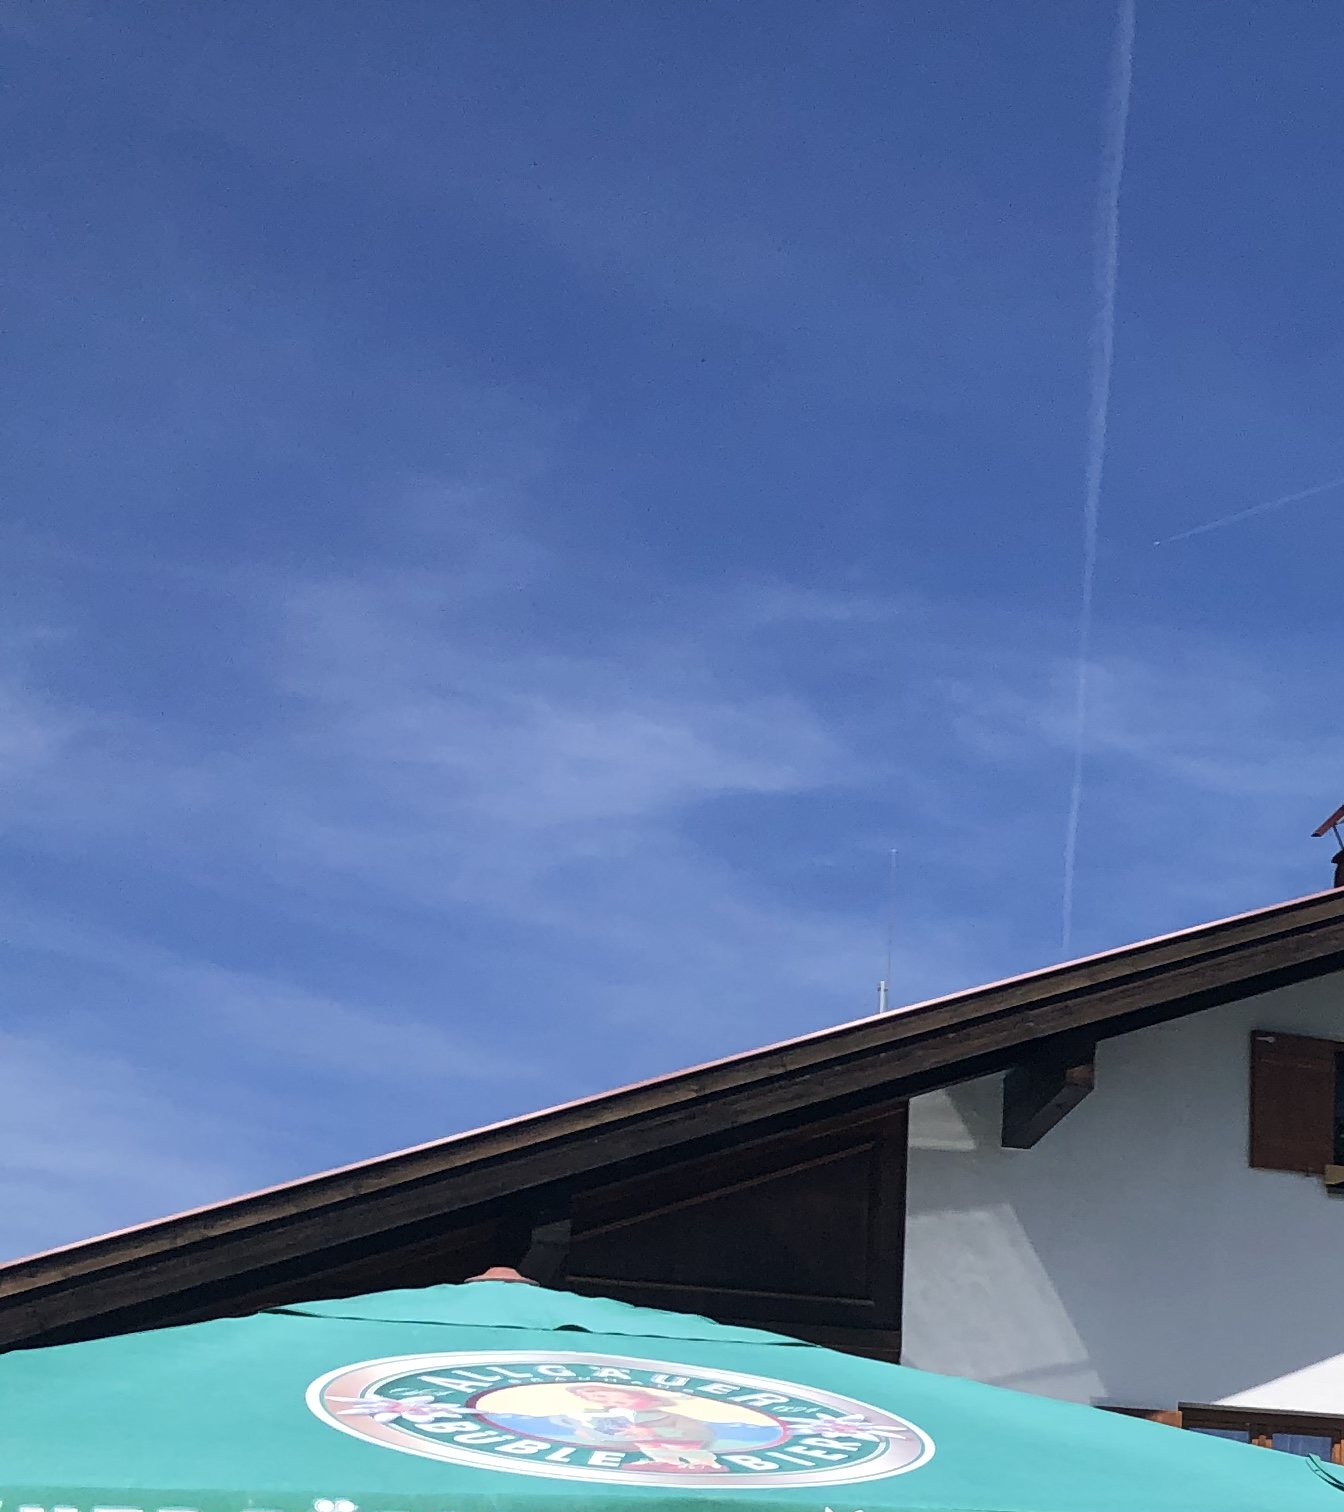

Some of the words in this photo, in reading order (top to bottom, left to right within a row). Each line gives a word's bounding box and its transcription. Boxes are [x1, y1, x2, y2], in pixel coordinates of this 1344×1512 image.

[416, 1363, 792, 1407] ALLGÄUER
[415, 1421, 626, 1468] BÜBLE
[721, 1437, 862, 1471] BIER
